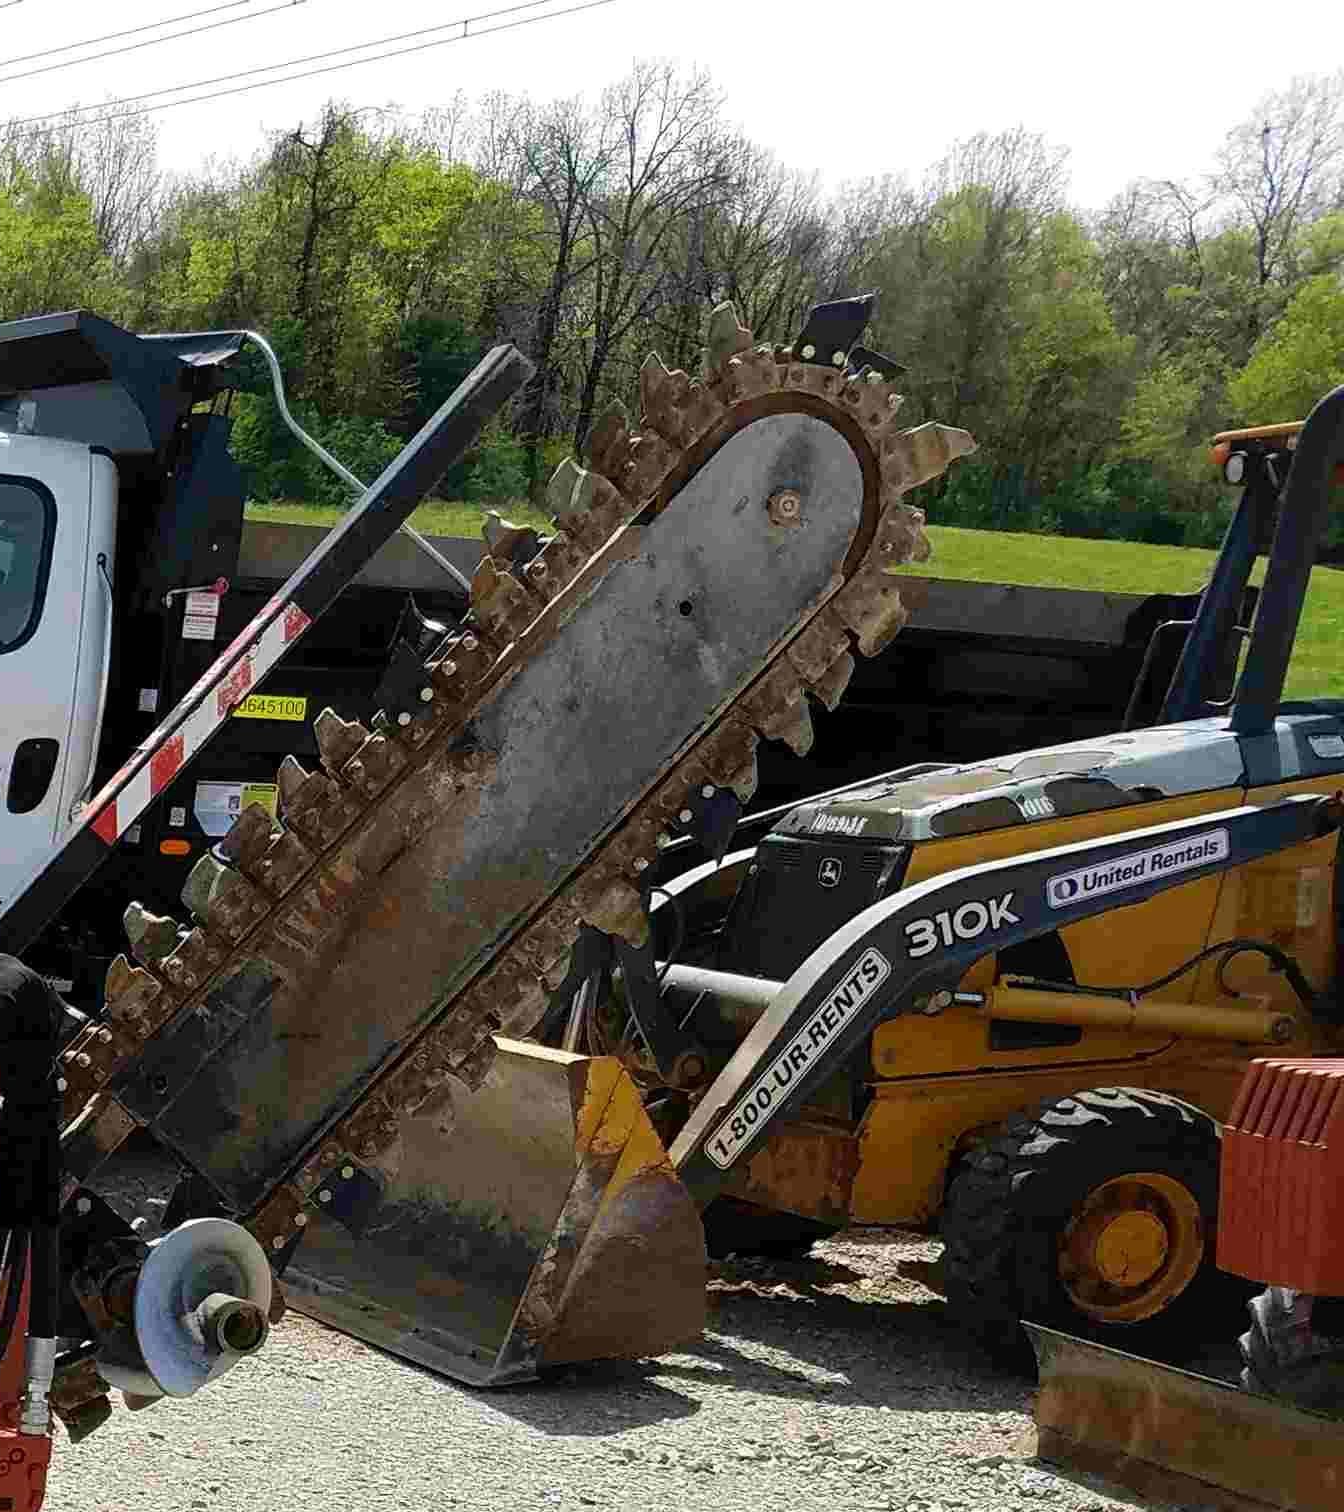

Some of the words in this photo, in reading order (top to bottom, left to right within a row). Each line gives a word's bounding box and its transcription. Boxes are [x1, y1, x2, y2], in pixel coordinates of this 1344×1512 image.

[1083, 857, 1147, 891] United
[1150, 839, 1219, 873] Rentals
[904, 892, 1022, 958] 310K
[714, 956, 880, 1157] 1-800-UR-RENTS
